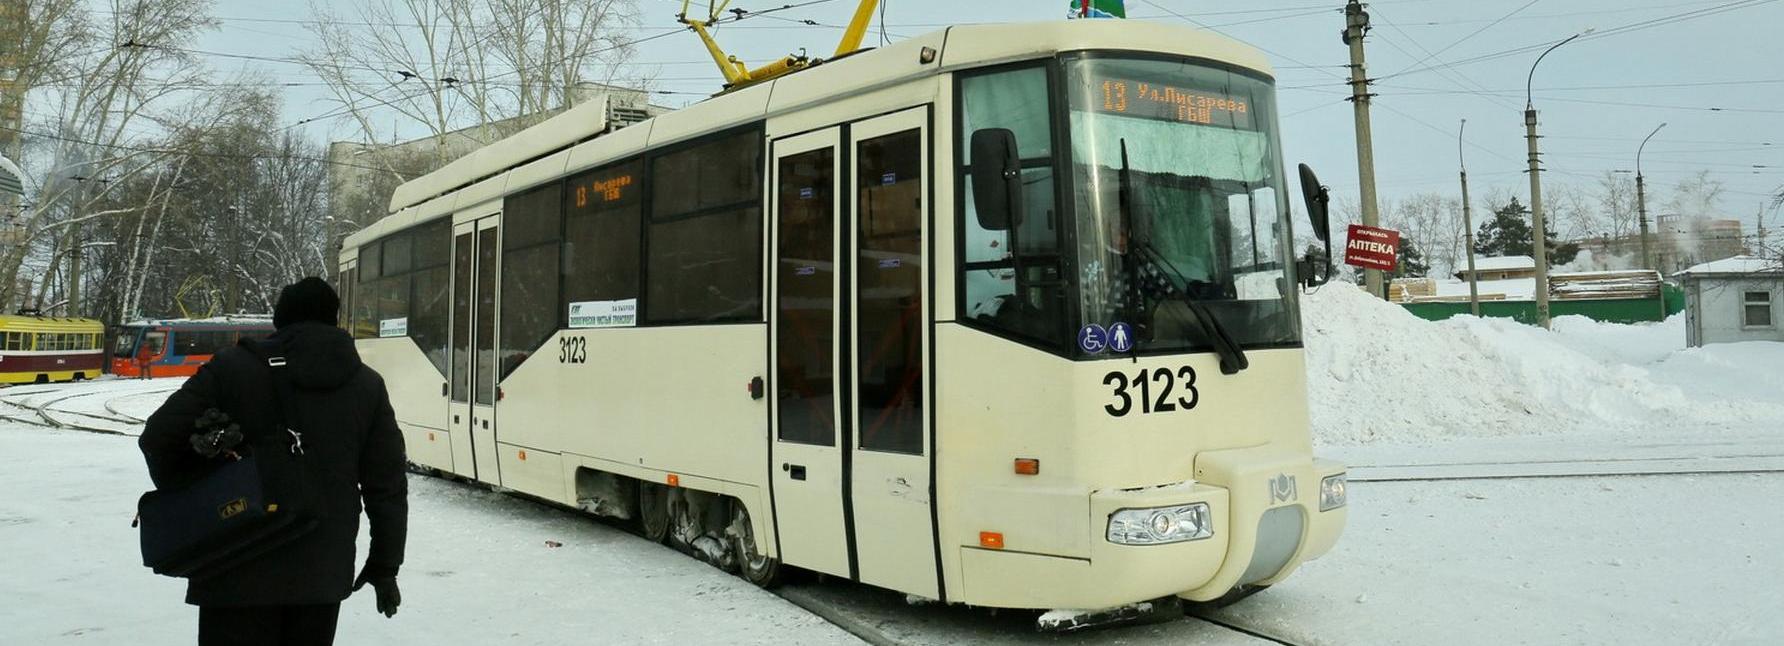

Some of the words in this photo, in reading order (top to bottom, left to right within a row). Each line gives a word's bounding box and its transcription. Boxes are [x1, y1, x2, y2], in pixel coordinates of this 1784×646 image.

[1103, 80, 1127, 112] 13
[1177, 106, 1211, 124] ГБШ
[576, 186, 586, 208] 13
[1348, 239, 1395, 255] АПТЕКА
[559, 336, 587, 364] 3123
[1102, 365, 1199, 418] 3123
